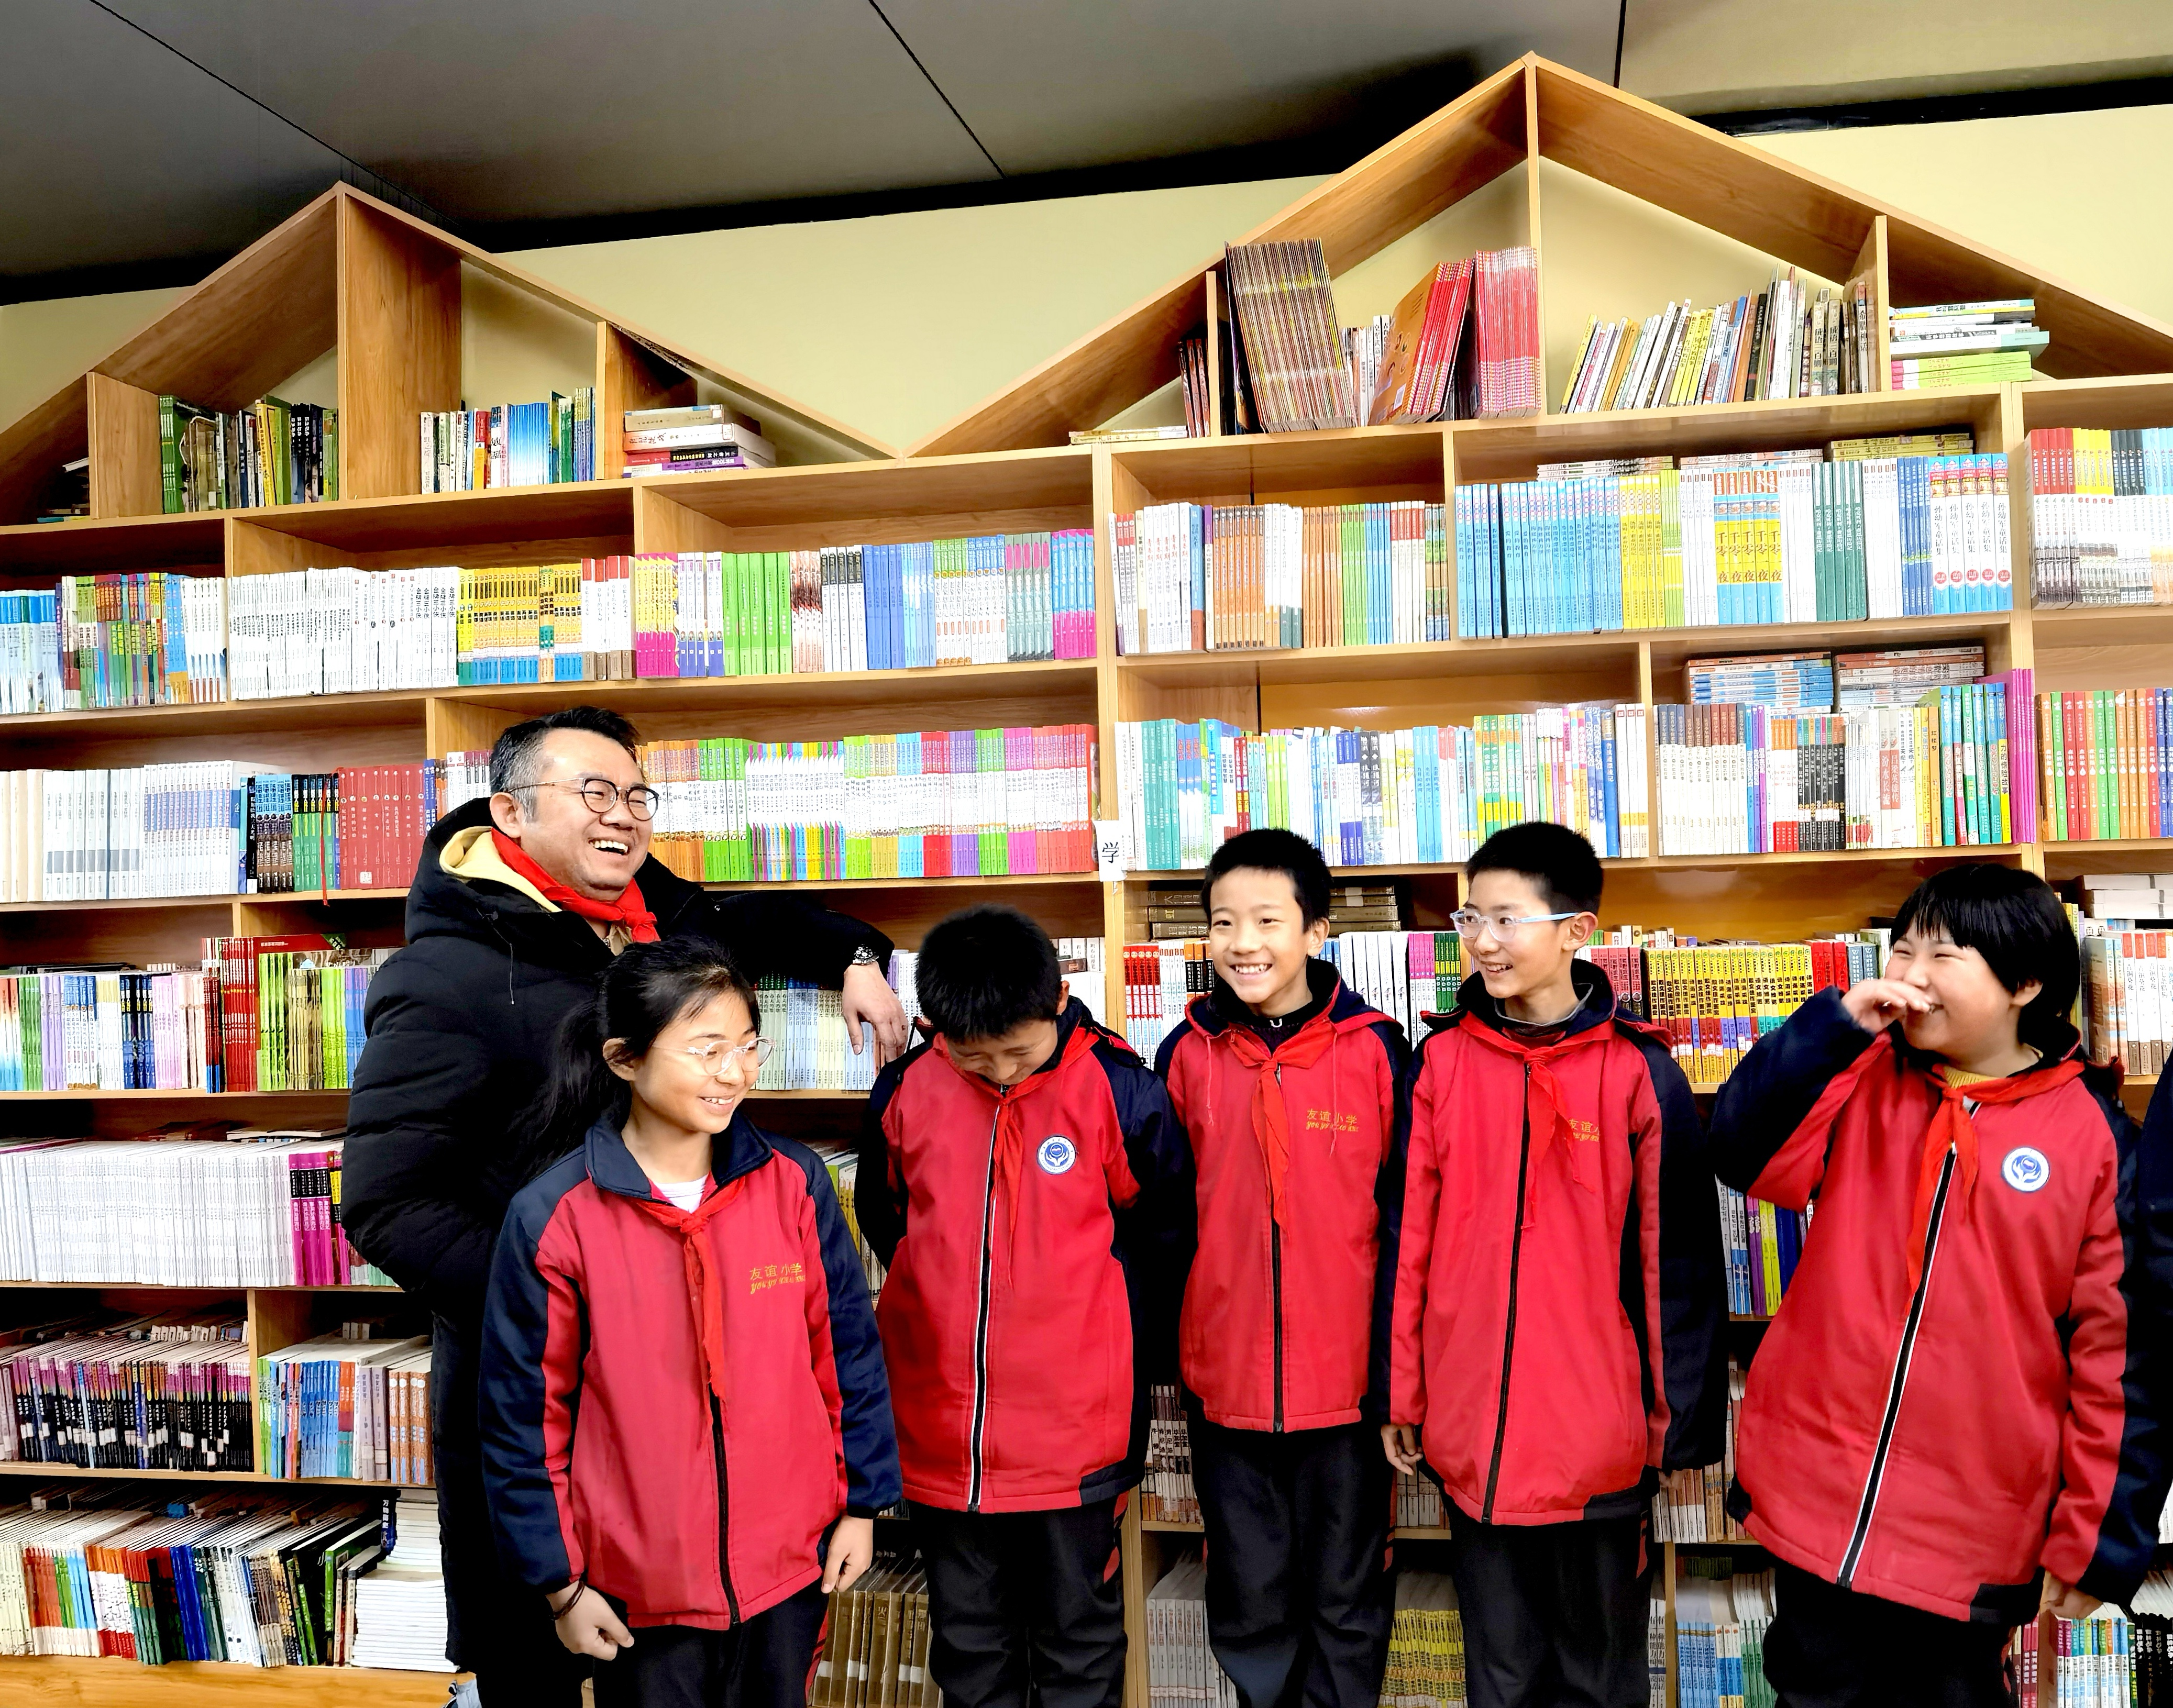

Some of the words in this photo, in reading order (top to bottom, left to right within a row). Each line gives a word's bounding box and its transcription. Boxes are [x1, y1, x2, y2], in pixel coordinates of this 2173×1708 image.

[1882, 755, 1890, 805] 汾水长流
[1101, 841, 1120, 864] 学
[1306, 1108, 1358, 1125] 友谊小学
[749, 1262, 802, 1281] 友谊小学
